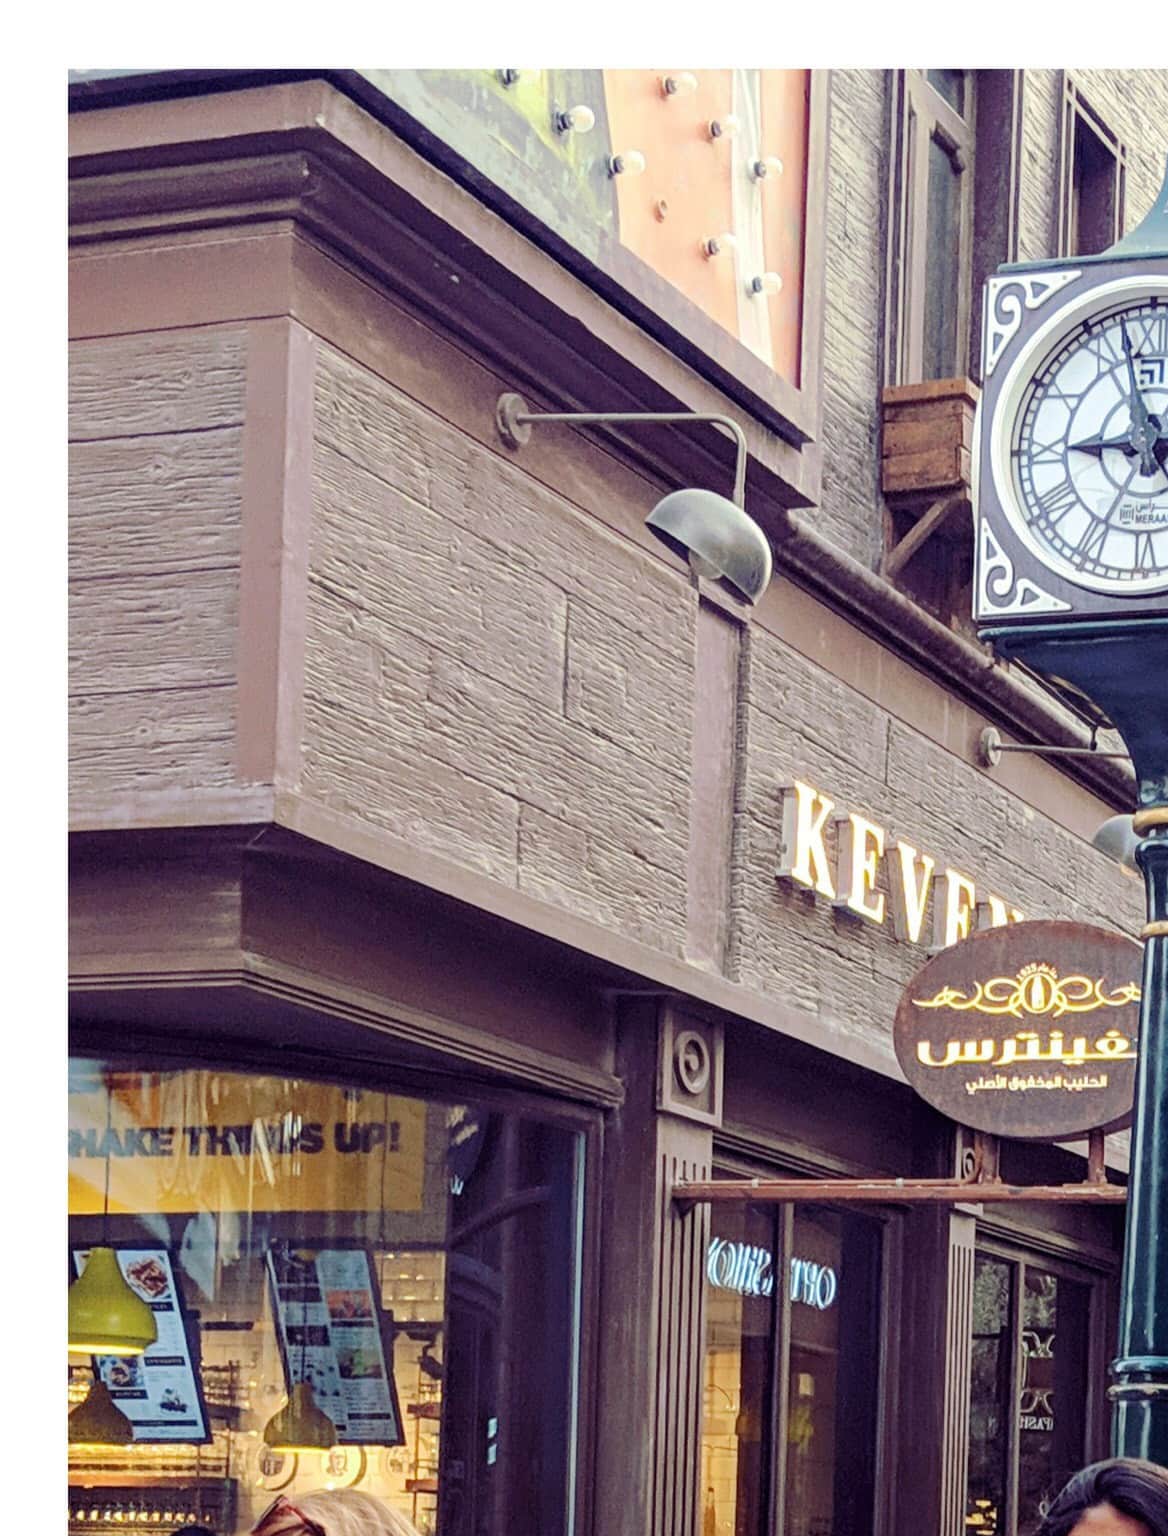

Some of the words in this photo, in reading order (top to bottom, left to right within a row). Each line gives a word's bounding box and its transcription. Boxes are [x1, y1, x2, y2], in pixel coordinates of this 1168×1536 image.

[792, 779, 1025, 948] KEVE
[917, 1029, 1138, 1066] فينترس
[1063, 1074, 1108, 1092] الحليب
[333, 1120, 400, 1154] UP!
